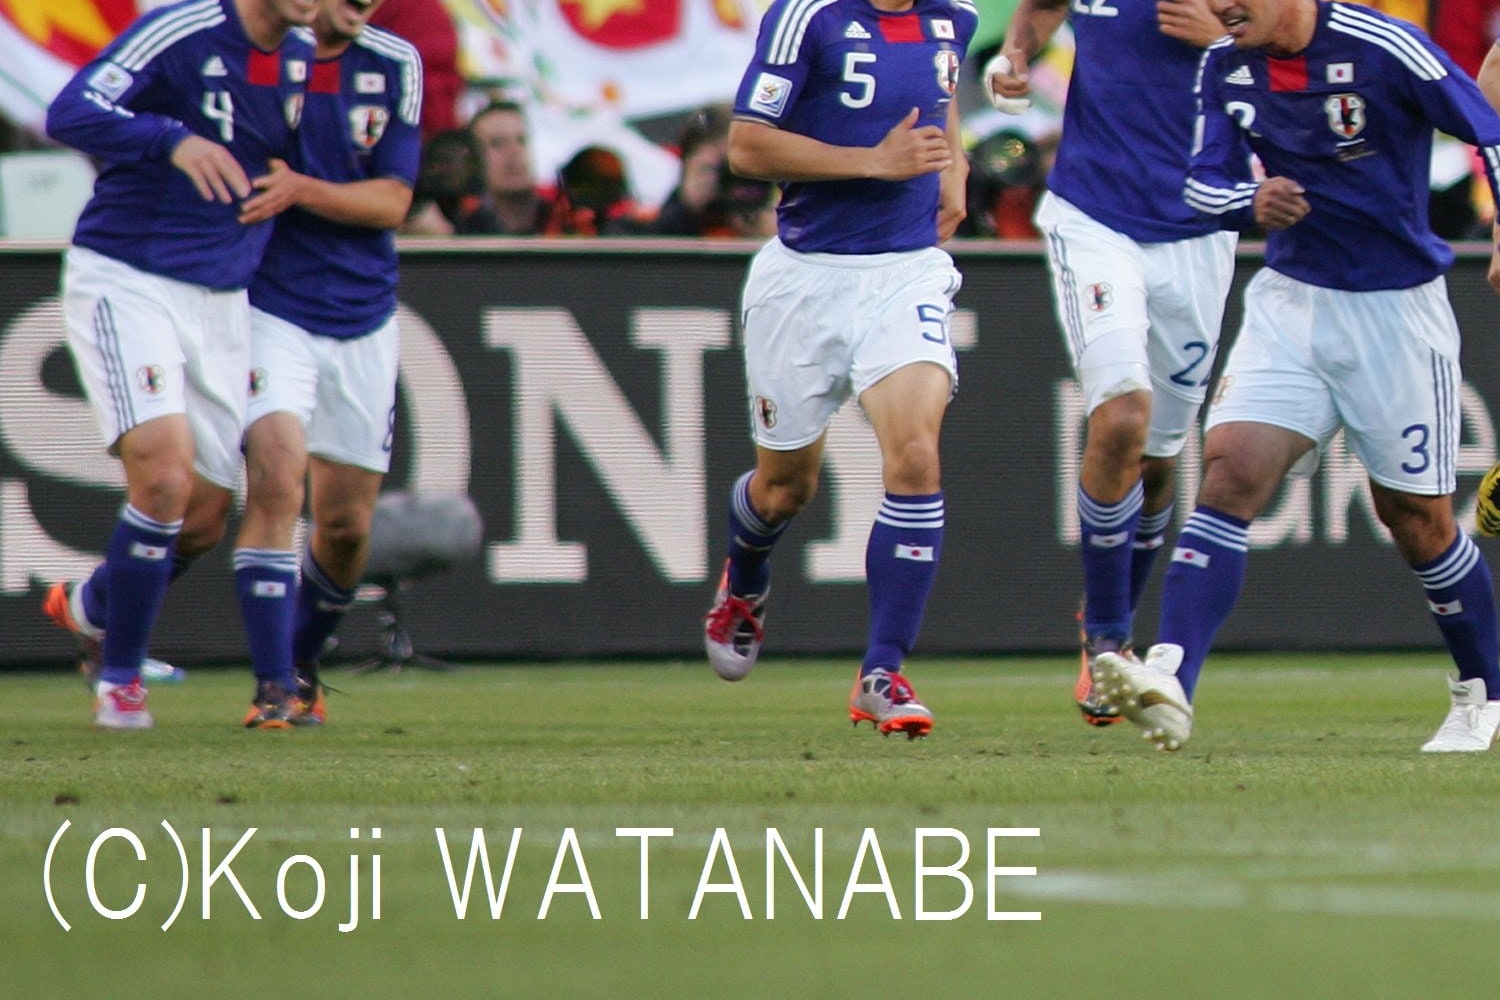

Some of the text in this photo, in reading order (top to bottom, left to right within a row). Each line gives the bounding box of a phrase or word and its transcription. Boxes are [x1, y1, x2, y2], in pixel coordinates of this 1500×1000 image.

[840, 51, 877, 109] 5
[203, 91, 235, 142] 4
[916, 303, 947, 346] 5
[0, 297, 978, 594] SN
[1401, 423, 1431, 474] 3
